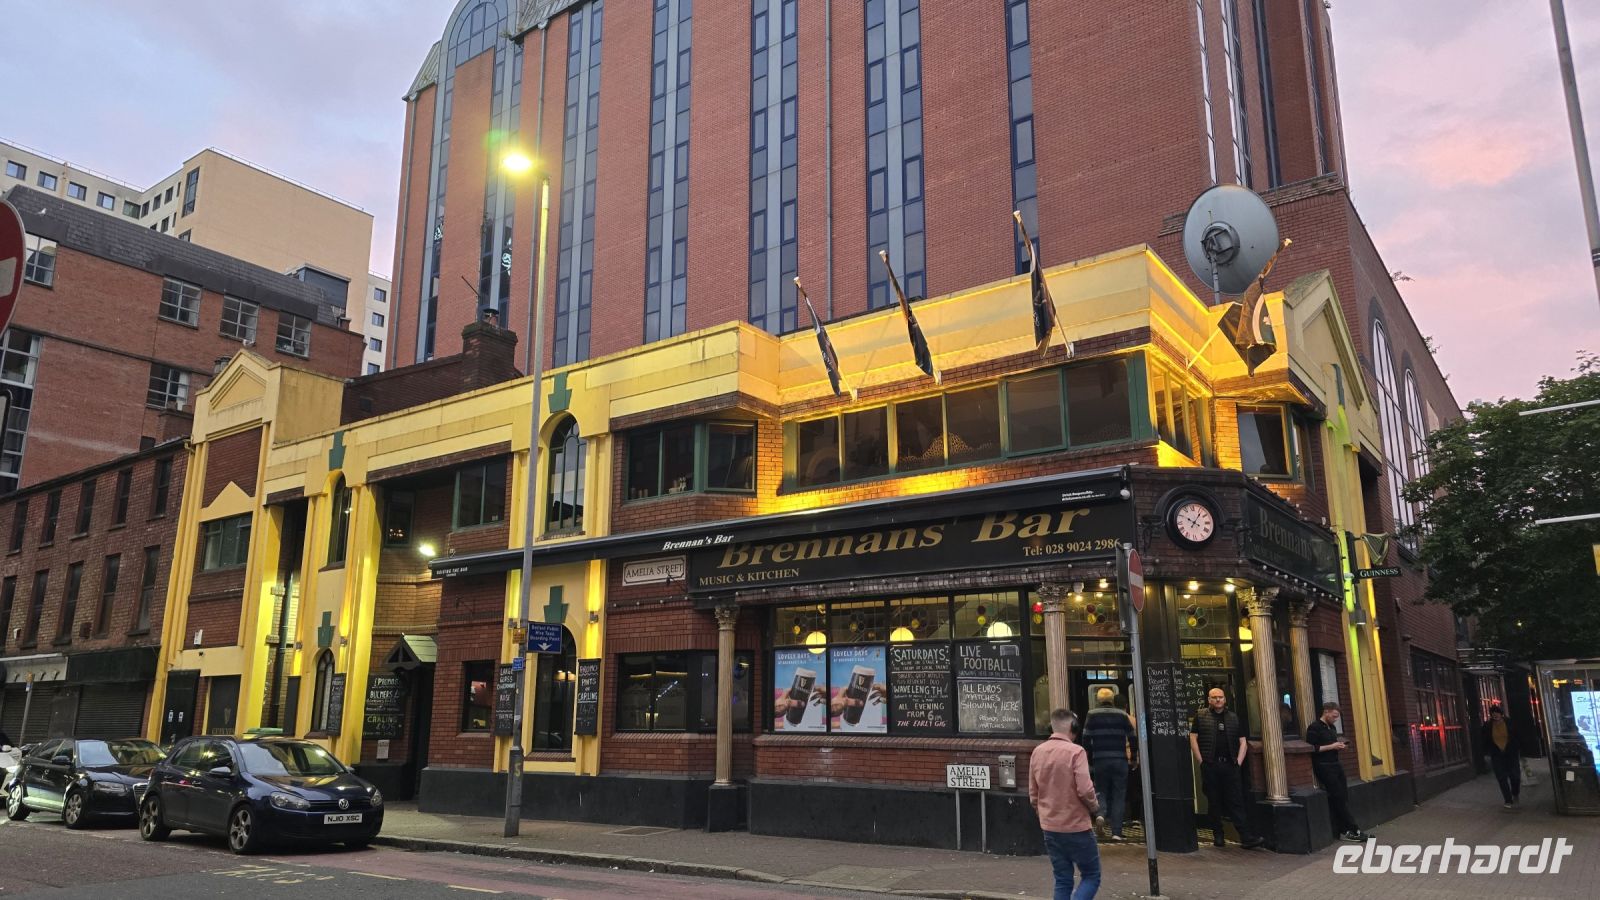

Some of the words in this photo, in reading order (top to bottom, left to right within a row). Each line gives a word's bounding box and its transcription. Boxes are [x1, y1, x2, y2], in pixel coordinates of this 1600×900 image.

[971, 508, 1090, 542] Bar
[662, 536, 712, 550] Brennan's
[713, 534, 734, 544] Bar
[1023, 546, 1043, 556] Tel:
[1046, 543, 1064, 555] 028
[1067, 541, 1092, 552] 9024
[626, 568, 654, 578] AMELIA
[657, 564, 682, 576] STREET
[700, 574, 734, 586] MUSIC
[736, 574, 745, 582] &
[747, 568, 800, 582] KITCHEN
[1360, 568, 1398, 578] GUINNESS
[894, 648, 946, 662] SATURDAYS
[960, 646, 981, 657] LIVE
[964, 658, 1014, 672] FOOTBALL
[894, 686, 942, 695] WAVELENGTH
[962, 684, 974, 693] ALL
[978, 684, 1002, 693] EUROS
[961, 700, 998, 713] SHOWING
[1001, 701, 1020, 711] HERE
[950, 766, 986, 776] AMELIA
[951, 777, 986, 787] STREET
